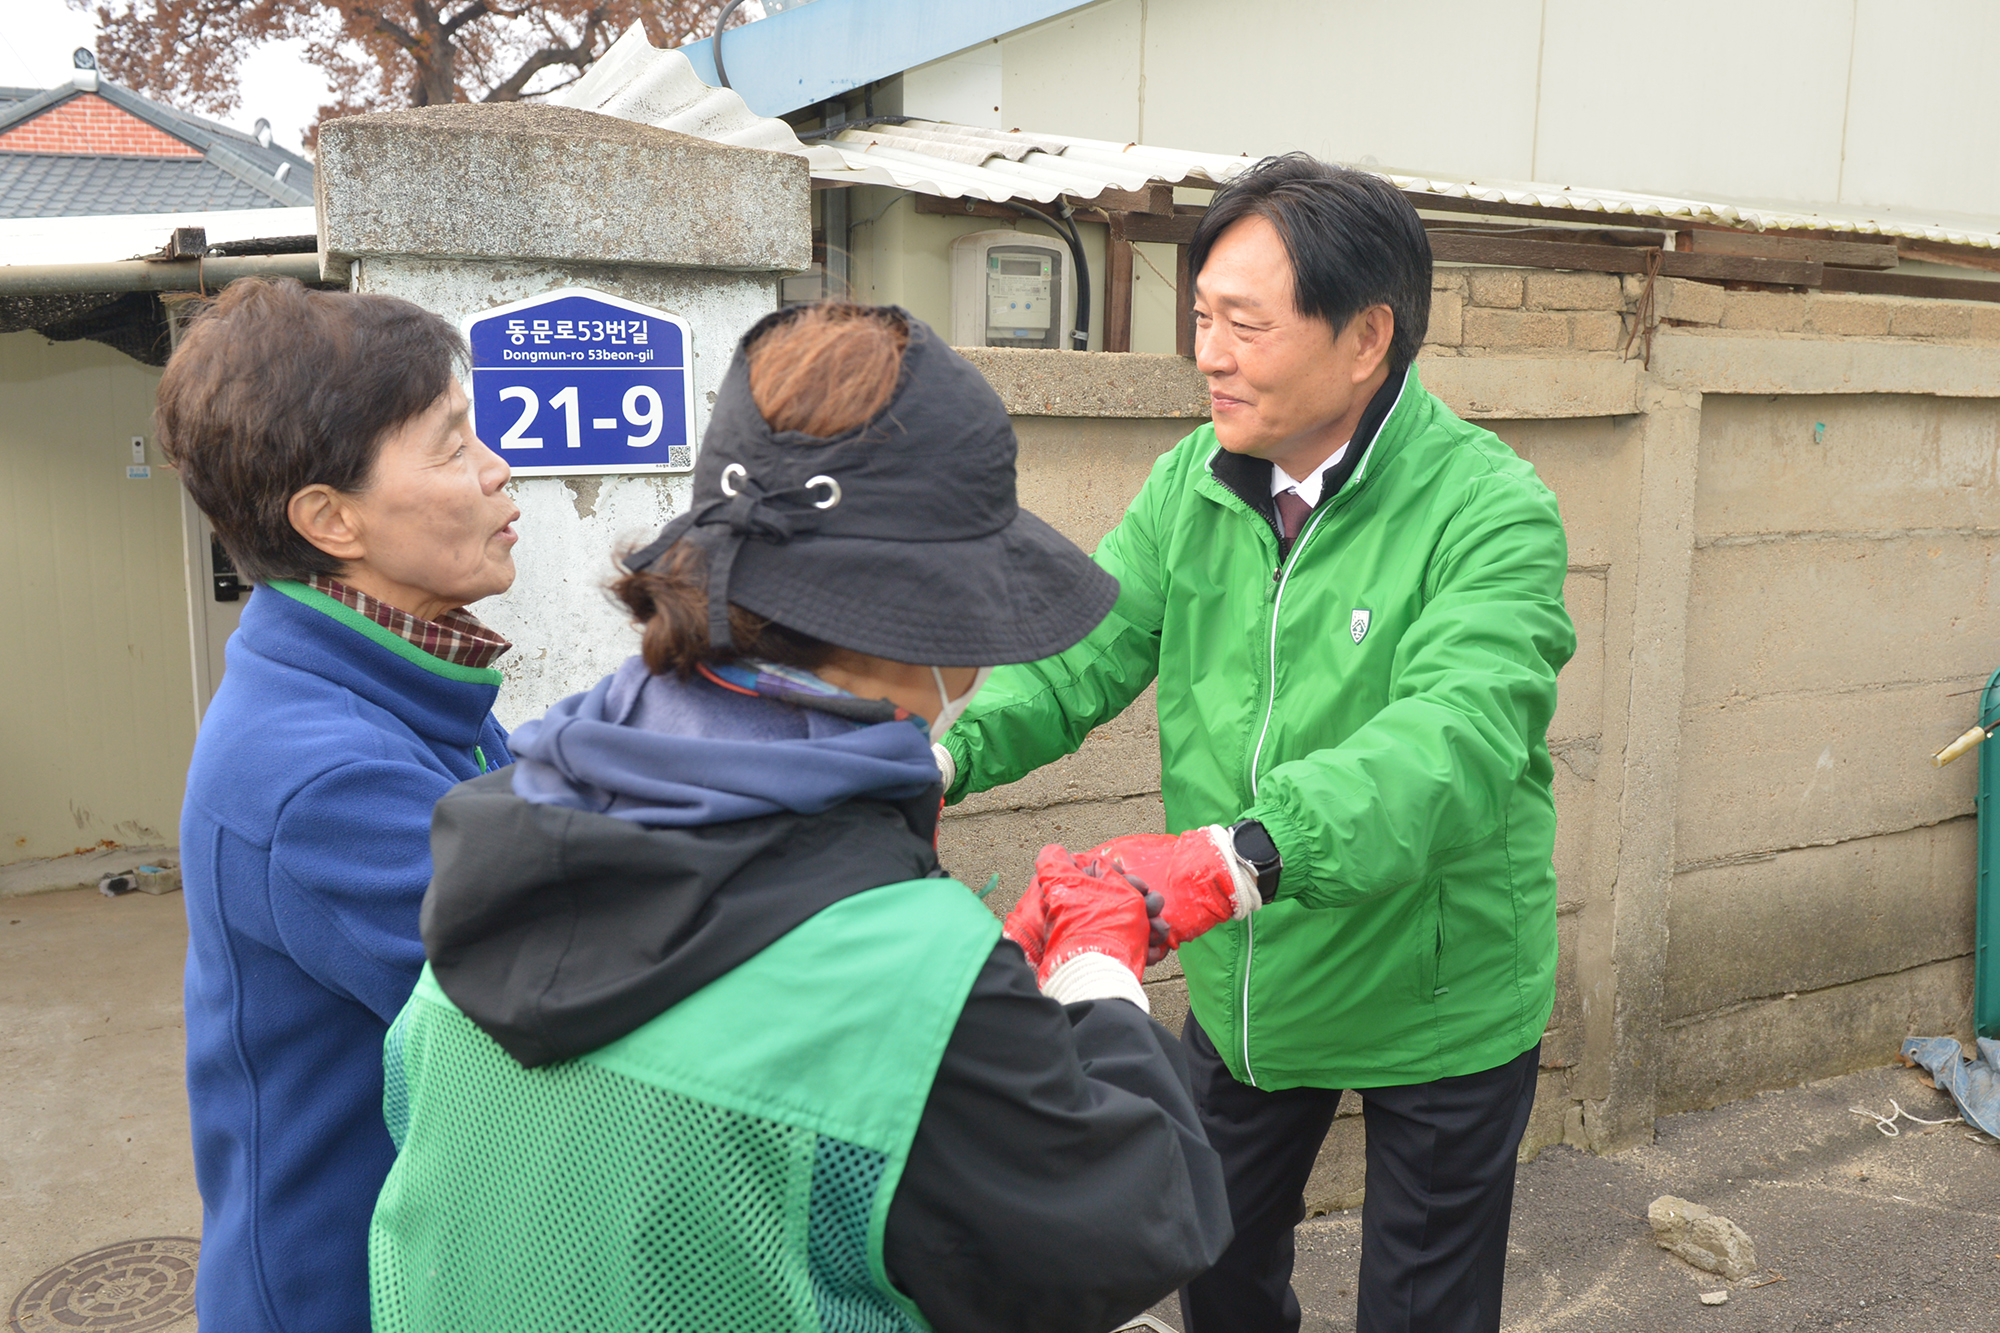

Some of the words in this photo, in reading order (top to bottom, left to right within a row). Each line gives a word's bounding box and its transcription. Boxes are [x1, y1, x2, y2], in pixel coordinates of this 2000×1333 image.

[505, 319, 649, 345] 동문로53번길
[503, 349, 585, 363] Dongmun-ro
[588, 349, 654, 363] 53beon-gil
[498, 385, 664, 450] 21-9
